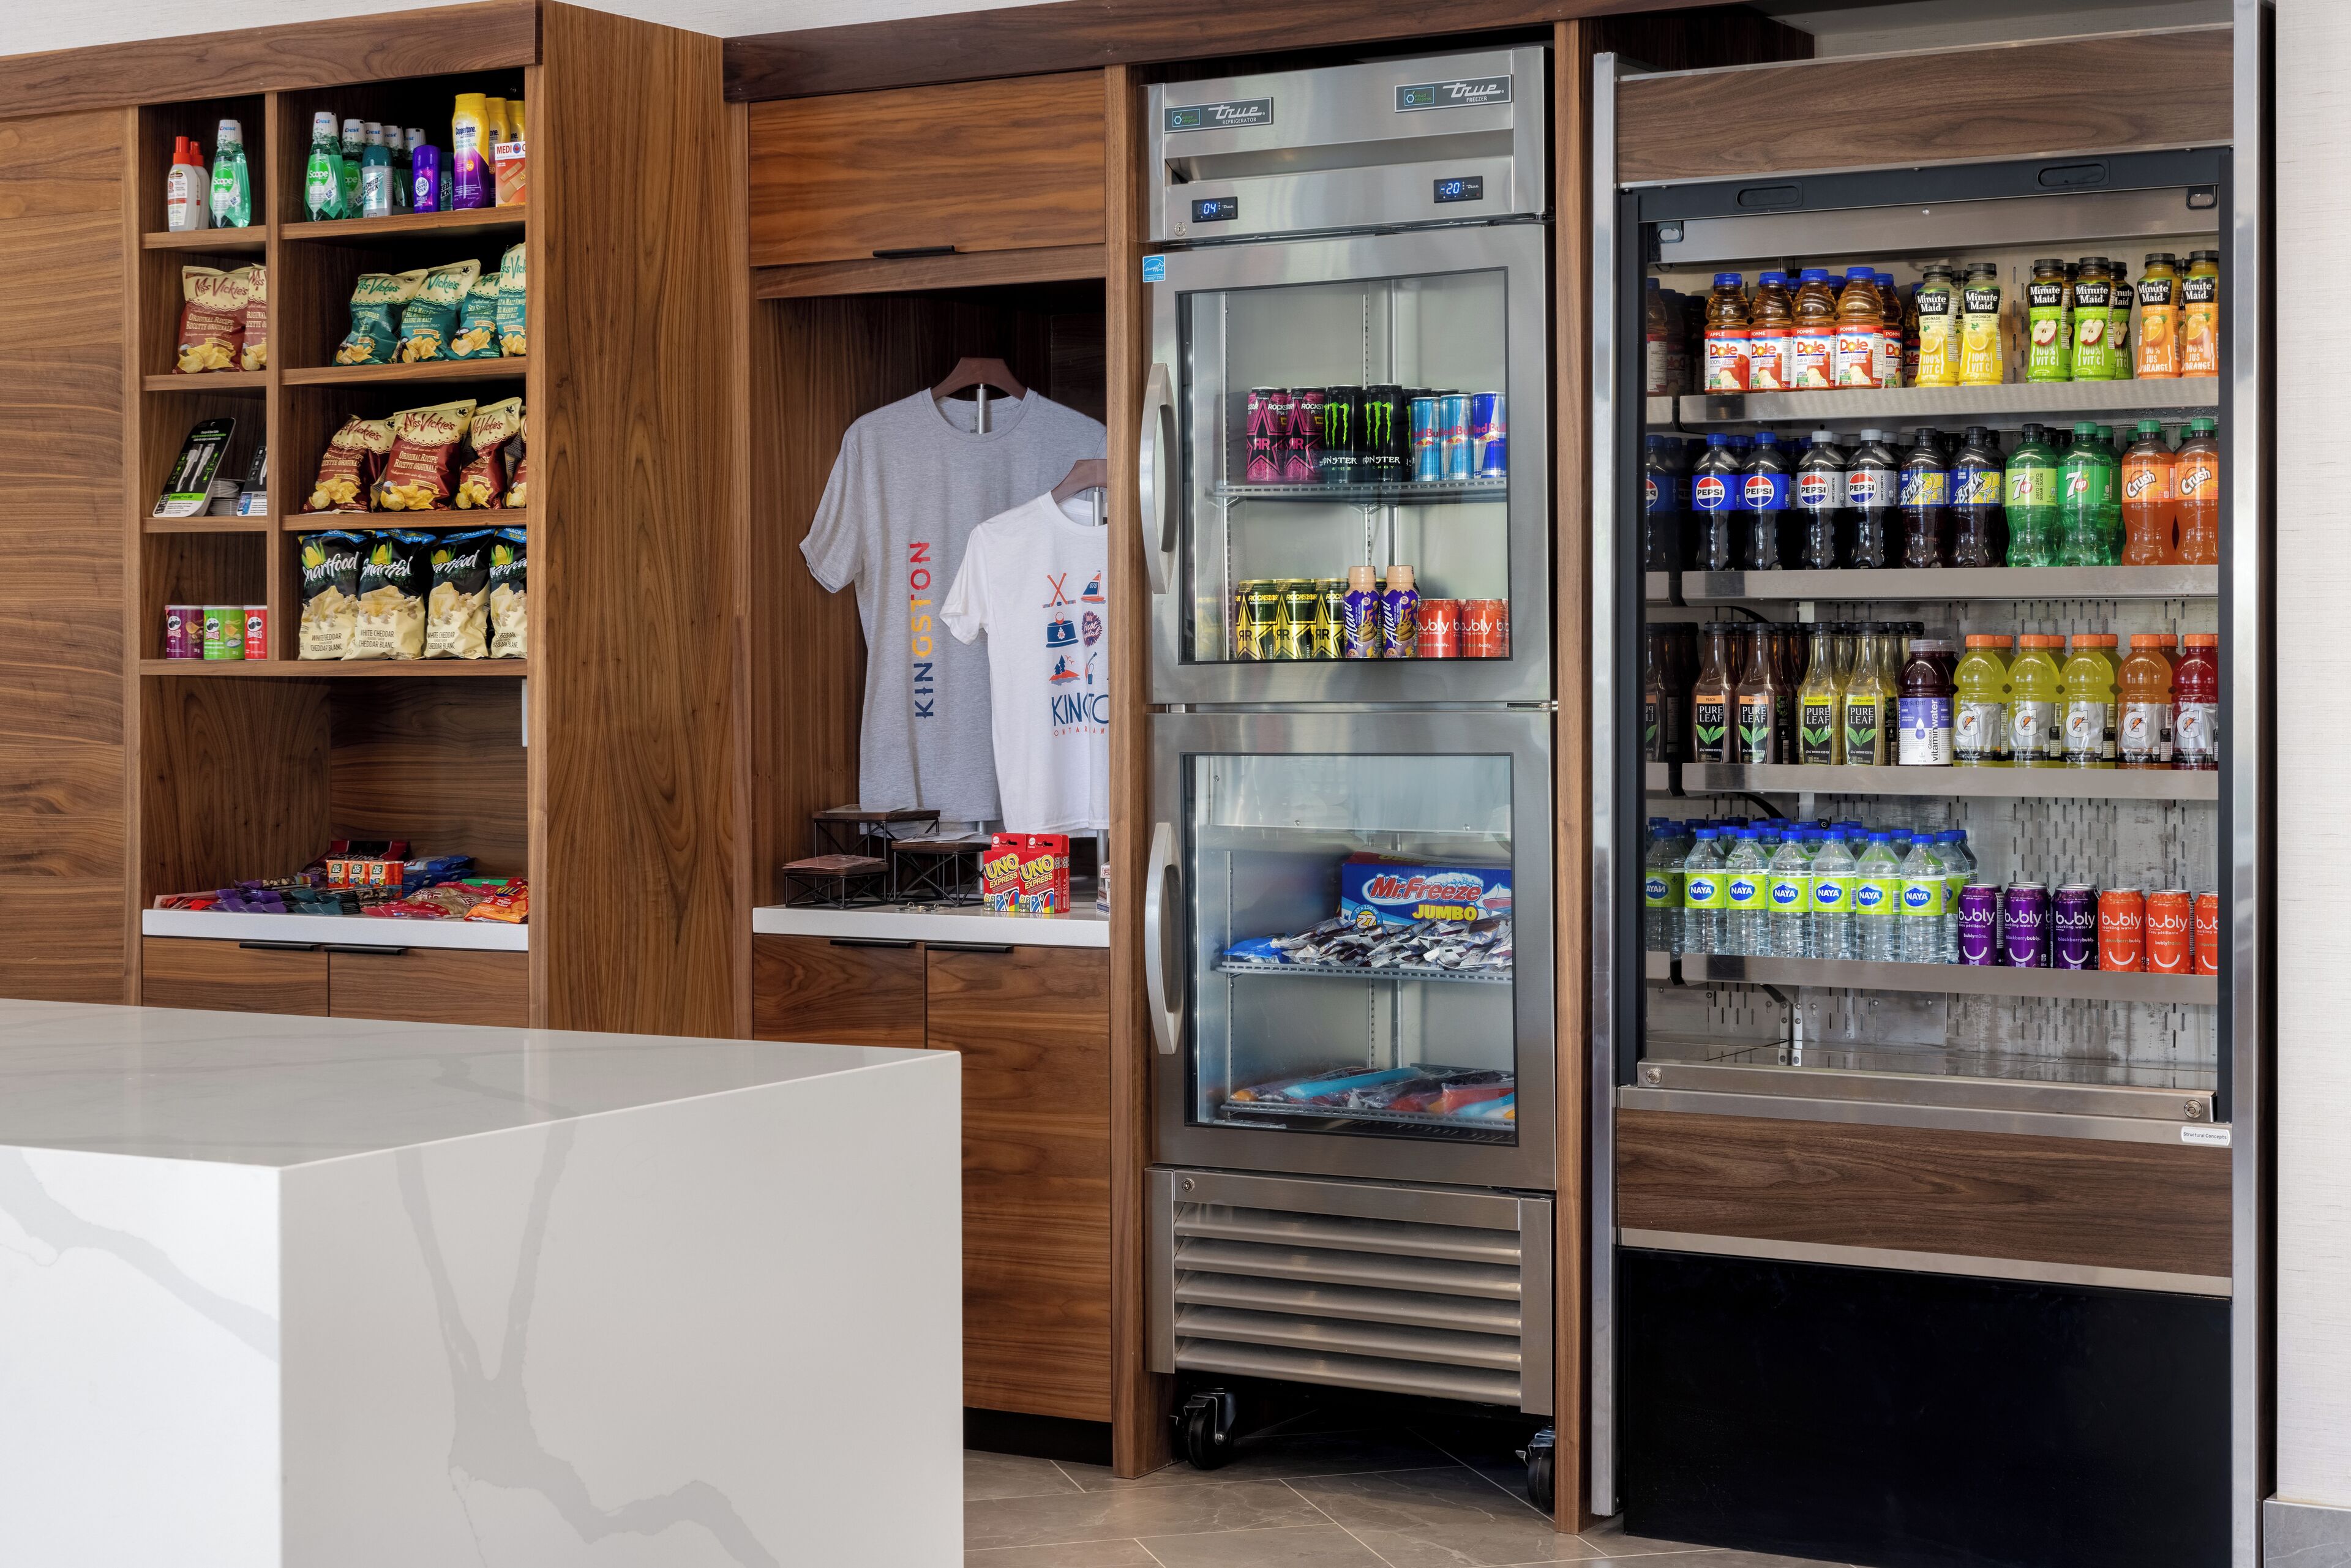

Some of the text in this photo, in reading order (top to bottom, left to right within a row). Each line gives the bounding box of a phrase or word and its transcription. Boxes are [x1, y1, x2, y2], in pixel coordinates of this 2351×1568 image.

[497, 146, 512, 154] MEDI
[309, 170, 328, 179] Scope
[1204, 203, 1216, 214] 04
[195, 277, 211, 296] Miss
[2030, 286, 2060, 294] Minute
[2076, 286, 2108, 294] Minute
[2139, 284, 2169, 294] Minute
[2183, 282, 2212, 291] Minute
[1917, 295, 1946, 304] Minute
[1966, 293, 1998, 302] Minute
[1710, 343, 1738, 357] Dole
[1752, 343, 1776, 356] Dole
[1797, 341, 1825, 354] Dole
[1840, 339, 1868, 352] Dole
[2036, 347, 2055, 356] 100%
[2082, 346, 2101, 356] 100%
[2187, 344, 2197, 353] 100
[1923, 355, 1940, 364] 100%
[1971, 353, 1990, 362] 100%
[2036, 356, 2055, 365] VIT C
[2082, 356, 2101, 366] VIT C
[1922, 365, 1940, 374] VIT C
[1971, 362, 1990, 372] VIT C
[399, 451, 438, 464] ORIGINAL RECIPE
[394, 459, 438, 473] RECETTE ORIGINALE
[2012, 473, 2027, 500] 7
[2066, 471, 2082, 497] 7
[2126, 470, 2157, 498] Crush
[2180, 467, 2212, 495] Crush
[909, 541, 934, 718] KINGSTON
[1345, 601, 1363, 648] Alani
[1384, 599, 1402, 648] Alani
[1700, 705, 1723, 714] PURE
[1742, 707, 1766, 715] PURE
[1807, 707, 1830, 716] PURE
[1850, 707, 1873, 716] PURE
[1742, 715, 1766, 723] LEAF
[1806, 716, 1830, 724] LEAF
[1850, 716, 1873, 724] LEAF
[984, 853, 1019, 882] UNO
[1019, 855, 1054, 882] UNO
[990, 872, 1018, 888] EXPRESS
[1025, 873, 1053, 890] EXPRESS
[1412, 904, 1477, 921] JUMBO
[1959, 907, 1995, 925] bubly
[2005, 909, 2042, 927] bubly
[1357, 915, 1376, 928] 27
[2056, 911, 2095, 928] bubly
[2102, 912, 2142, 929] bubly
[2148, 913, 2188, 932] bubly
